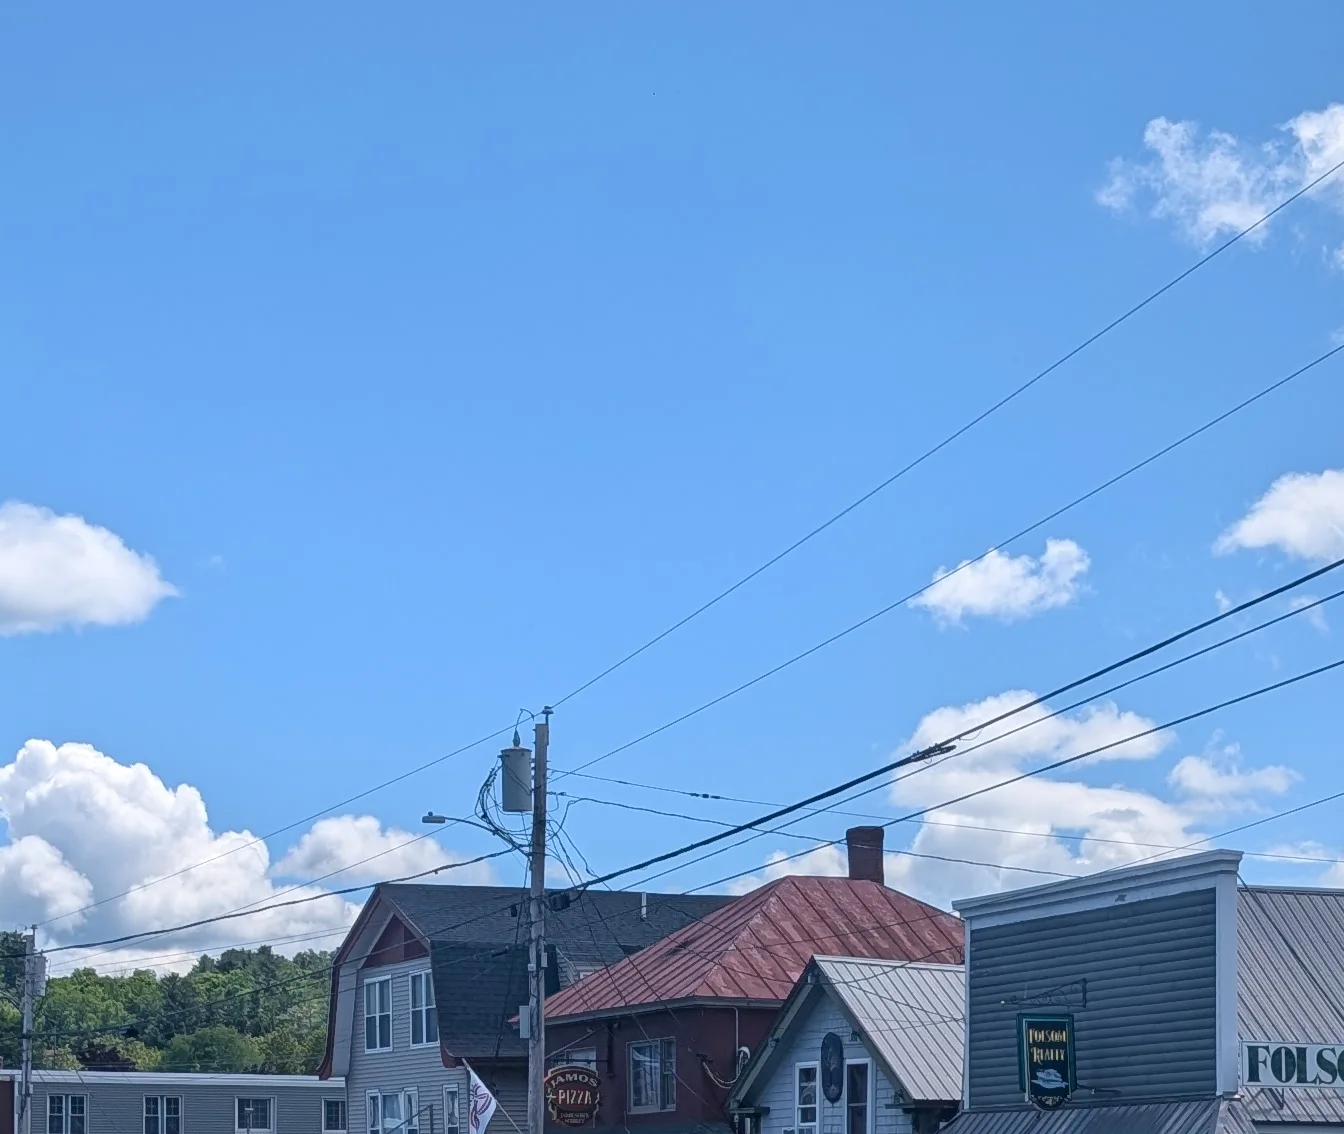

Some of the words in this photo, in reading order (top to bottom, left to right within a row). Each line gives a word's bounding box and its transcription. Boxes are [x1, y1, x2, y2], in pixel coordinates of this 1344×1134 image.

[1028, 1028, 1067, 1044] FOLSOM
[1030, 1046, 1066, 1065] REALTY
[558, 1089, 592, 1105] PIZZA
